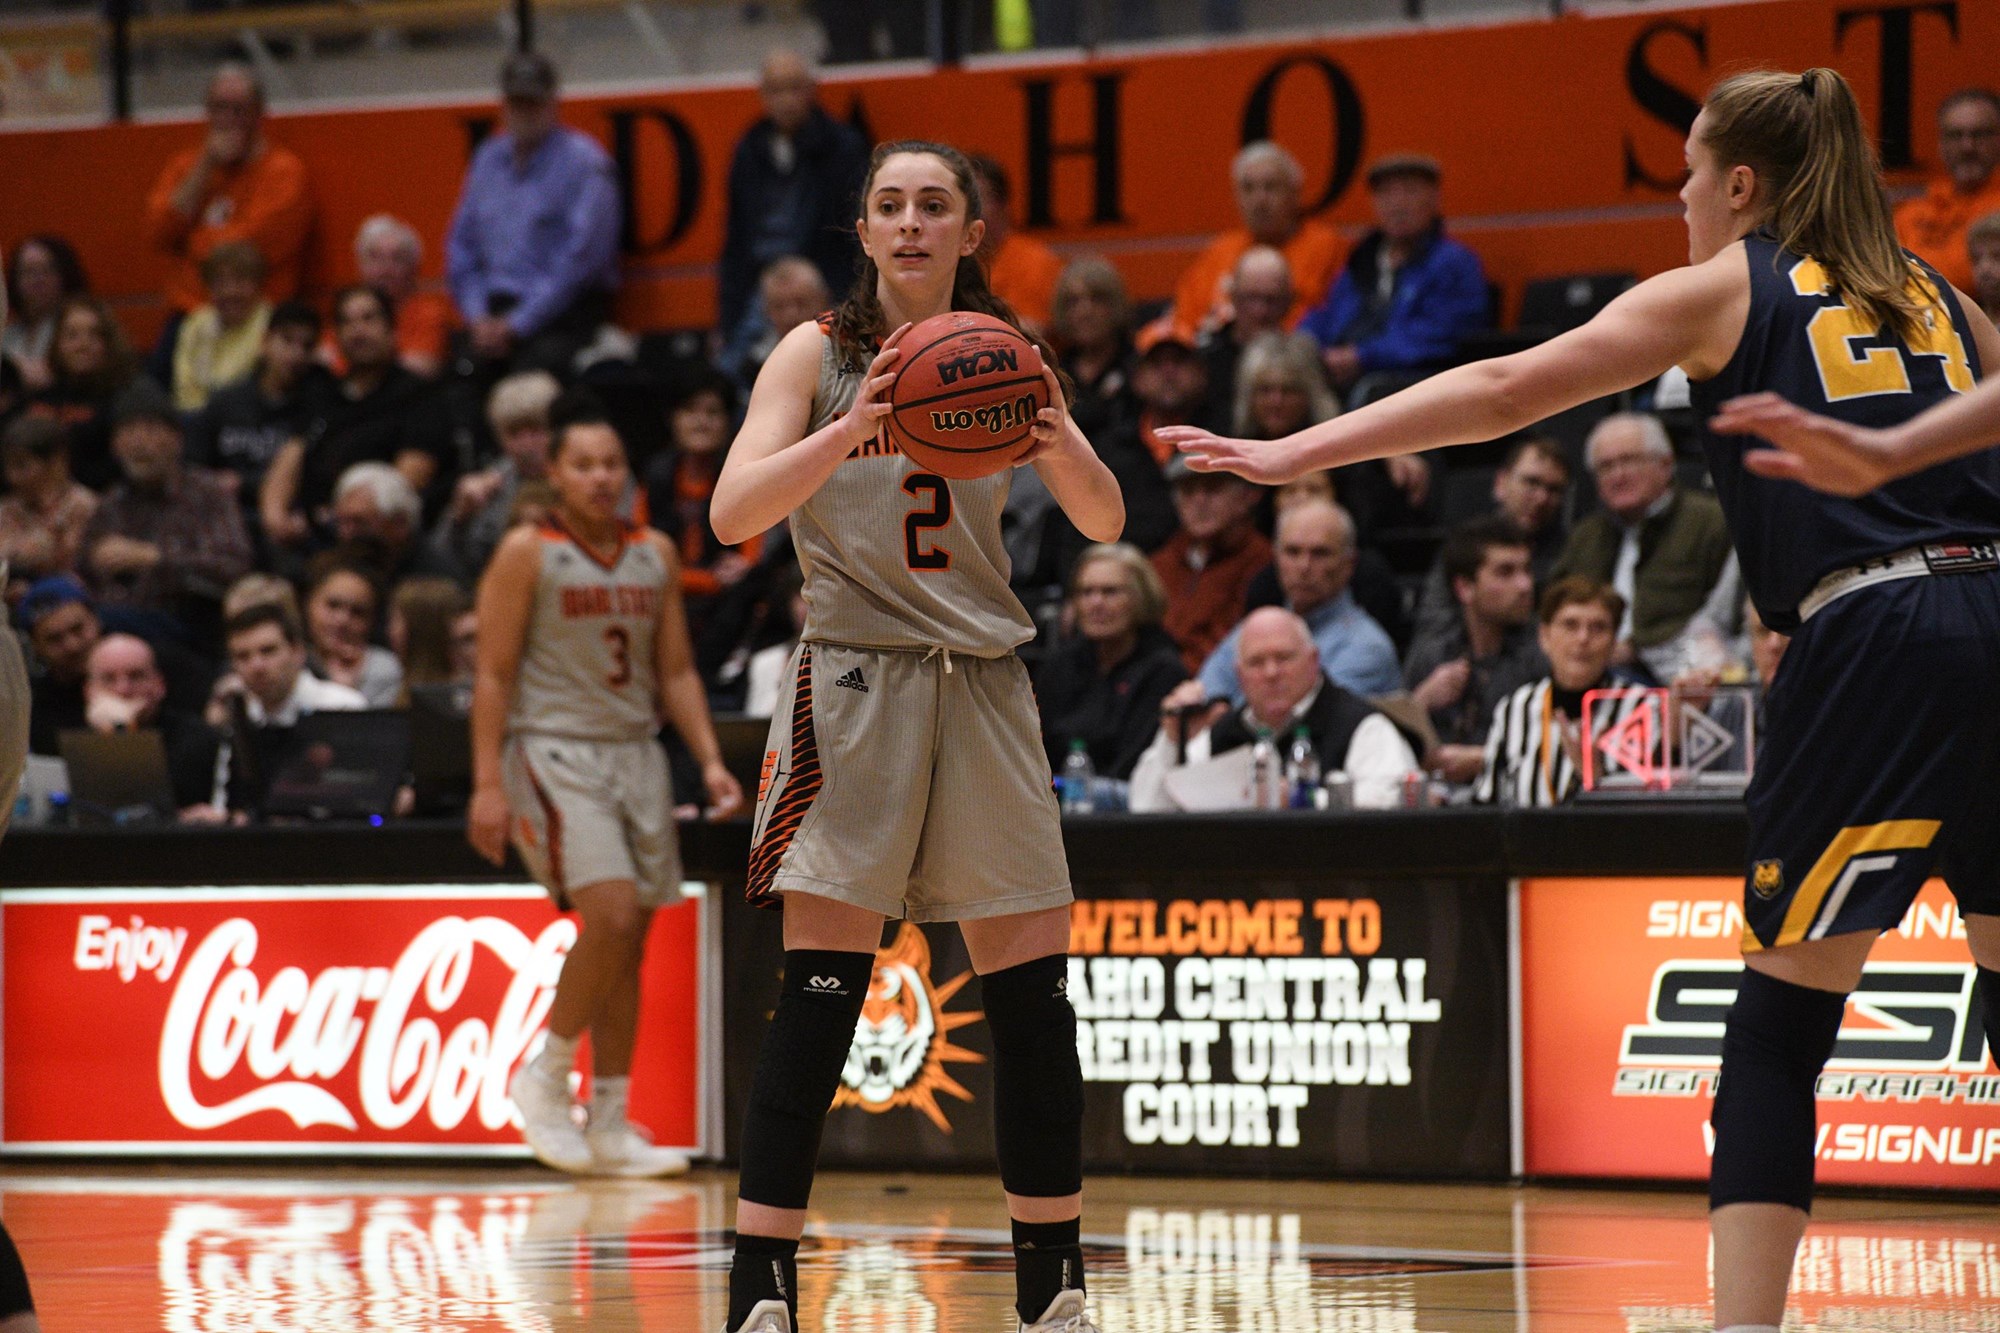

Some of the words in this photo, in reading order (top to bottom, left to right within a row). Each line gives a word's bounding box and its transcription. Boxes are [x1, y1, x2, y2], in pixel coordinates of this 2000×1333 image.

[937, 349, 1018, 386] NCAA
[930, 393, 1038, 435] Wilson
[900, 470, 953, 572] 2
[603, 622, 632, 688] 3
[835, 679, 869, 693] adidas
[74, 914, 188, 982] Enjoy
[1068, 899, 1304, 955] WELCOME
[1313, 899, 1382, 955] TO
[1067, 957, 1166, 1019] AHO
[1174, 957, 1442, 1022] CENTRAL
[158, 915, 588, 1132] Coca-Col
[1076, 1020, 1220, 1082] REDIT
[1229, 1021, 1412, 1085] UNION
[1122, 1082, 1309, 1147] COURT
